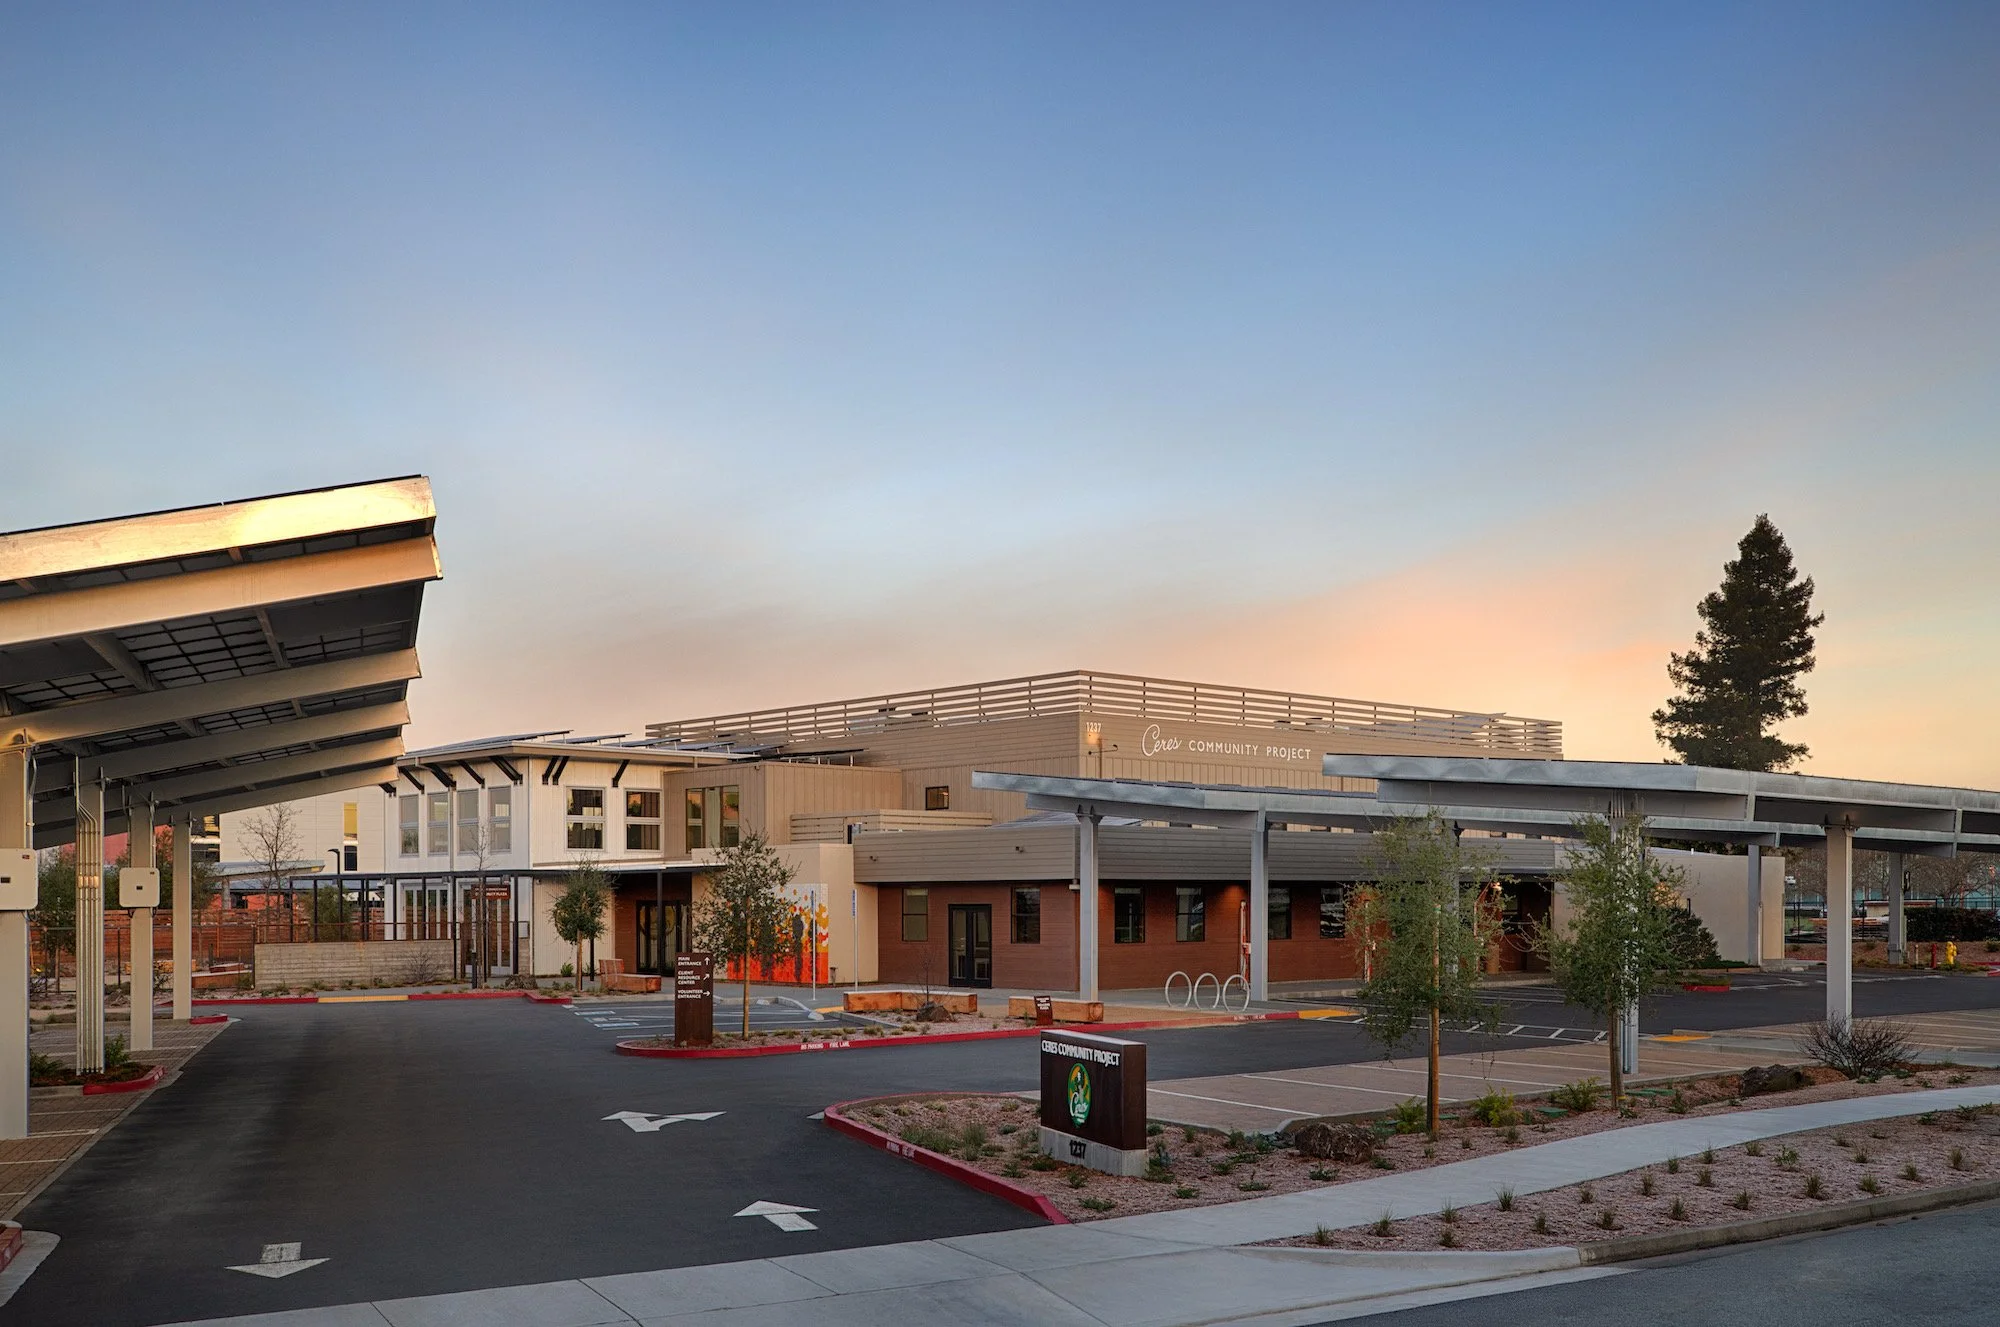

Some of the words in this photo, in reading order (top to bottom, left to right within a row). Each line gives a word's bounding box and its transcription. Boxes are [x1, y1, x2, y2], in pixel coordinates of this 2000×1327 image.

[1086, 722, 1101, 733] 1237
[1142, 724, 1182, 757] Ceres
[1188, 740, 1259, 756] COMMUNITY
[1266, 747, 1311, 761] PROJECT
[1041, 1040, 1058, 1054] CERES
[1058, 1043, 1093, 1061] COMMUNITY
[1093, 1049, 1120, 1067] PROJECT
[1069, 1140, 1086, 1159] 1237
